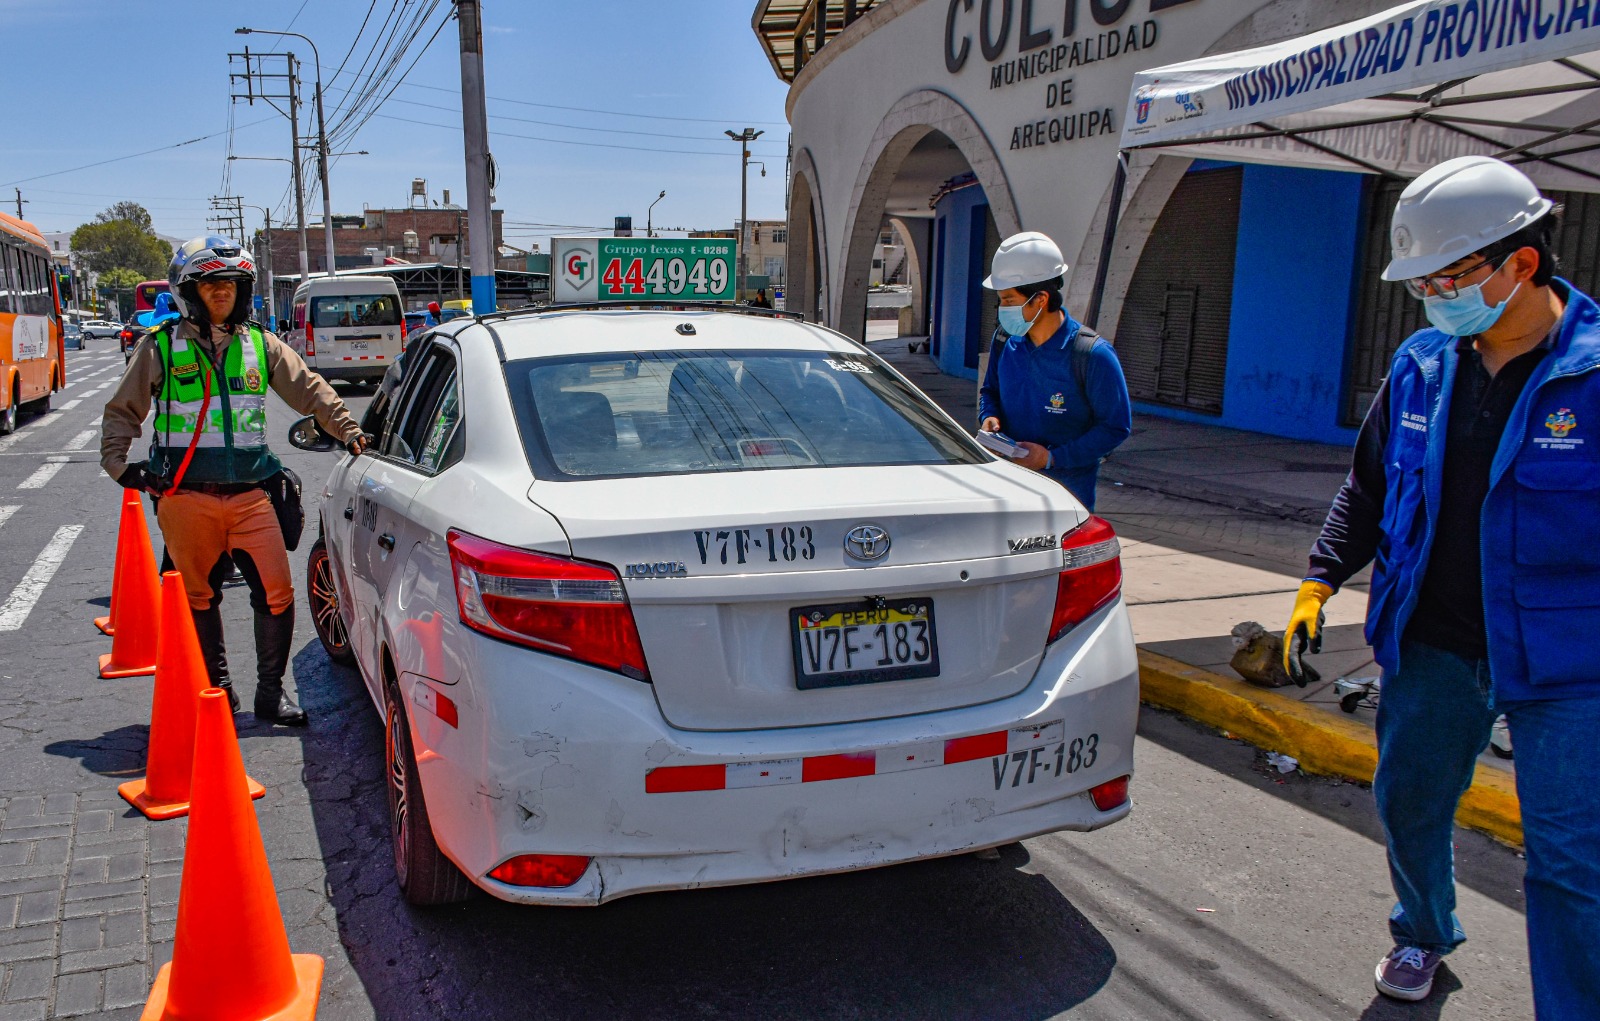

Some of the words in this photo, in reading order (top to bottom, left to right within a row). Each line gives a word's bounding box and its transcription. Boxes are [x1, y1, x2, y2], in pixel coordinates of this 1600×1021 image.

[990, 19, 1157, 89] MUNICIPALIDAD
[1225, 17, 1413, 110] MUNICIPALIDAD
[1046, 79, 1073, 109] DE
[1010, 108, 1116, 150] AREQUIPA
[604, 244, 647, 257] Grupo
[651, 243, 684, 255] texas
[602, 257, 729, 295] 444949
[693, 525, 816, 565] V7F-183
[625, 560, 688, 577] TOYOTA
[804, 620, 930, 672] V7F-183
[992, 733, 1099, 791] V7F-183
